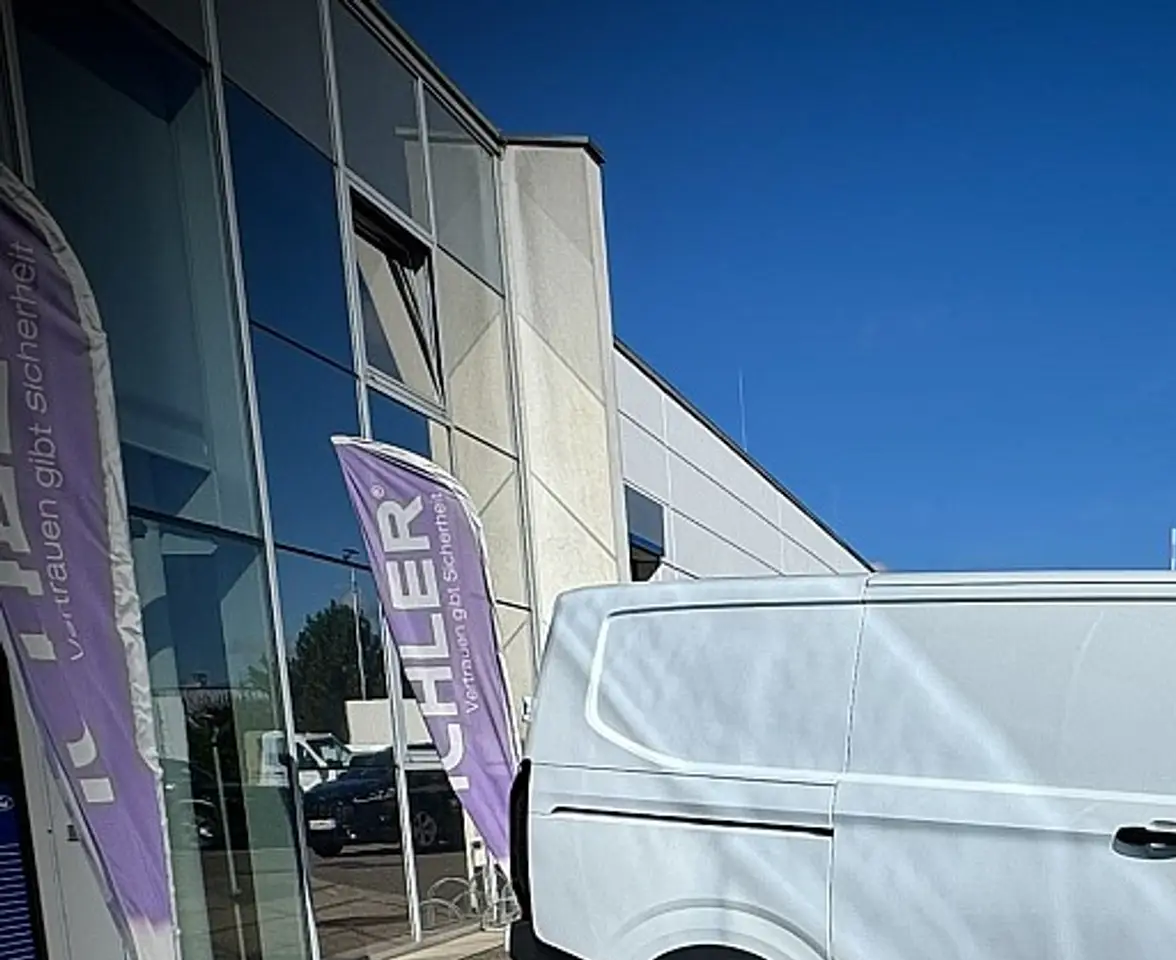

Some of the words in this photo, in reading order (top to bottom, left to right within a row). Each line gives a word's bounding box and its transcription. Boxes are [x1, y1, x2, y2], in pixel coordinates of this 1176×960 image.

[27, 421, 64, 489] gibt
[431, 491, 459, 583] Sicherheit
[455, 624, 480, 715] Vertrauen
